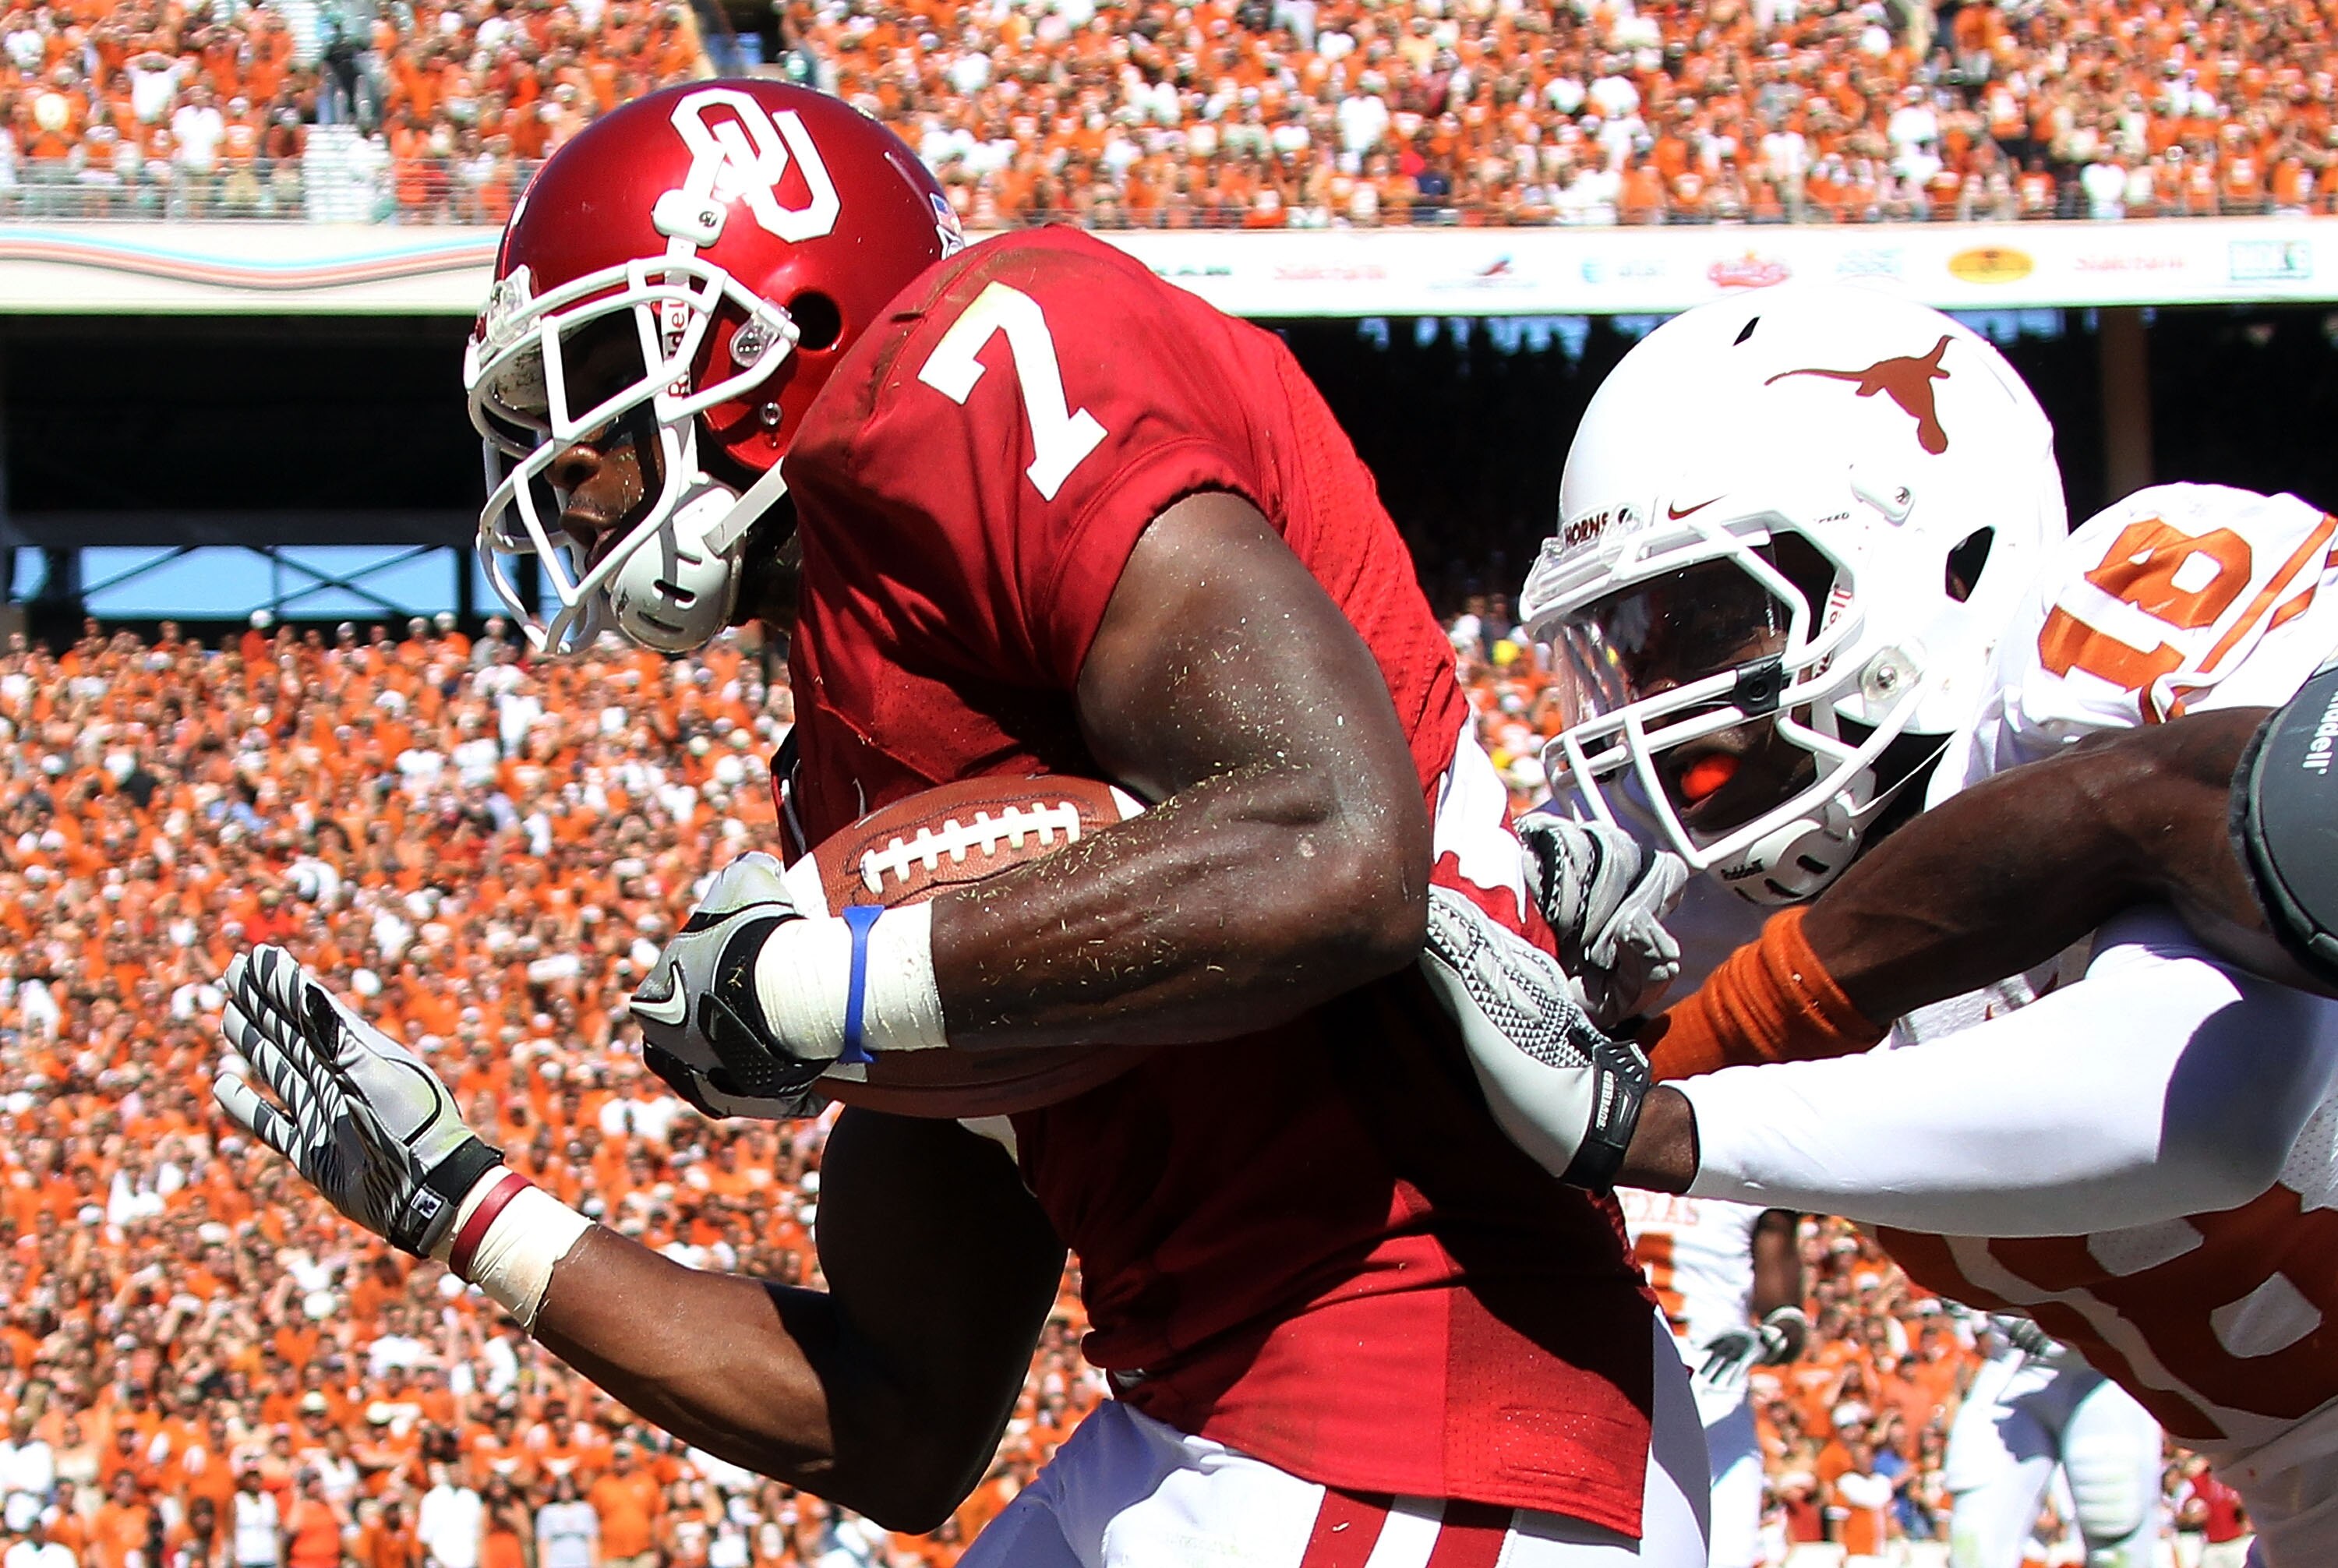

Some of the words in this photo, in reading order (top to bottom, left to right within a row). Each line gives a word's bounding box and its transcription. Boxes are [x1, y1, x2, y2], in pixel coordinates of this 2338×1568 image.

[669, 87, 841, 243] OU
[917, 281, 1109, 502] 7
[2038, 517, 2252, 694] 18
